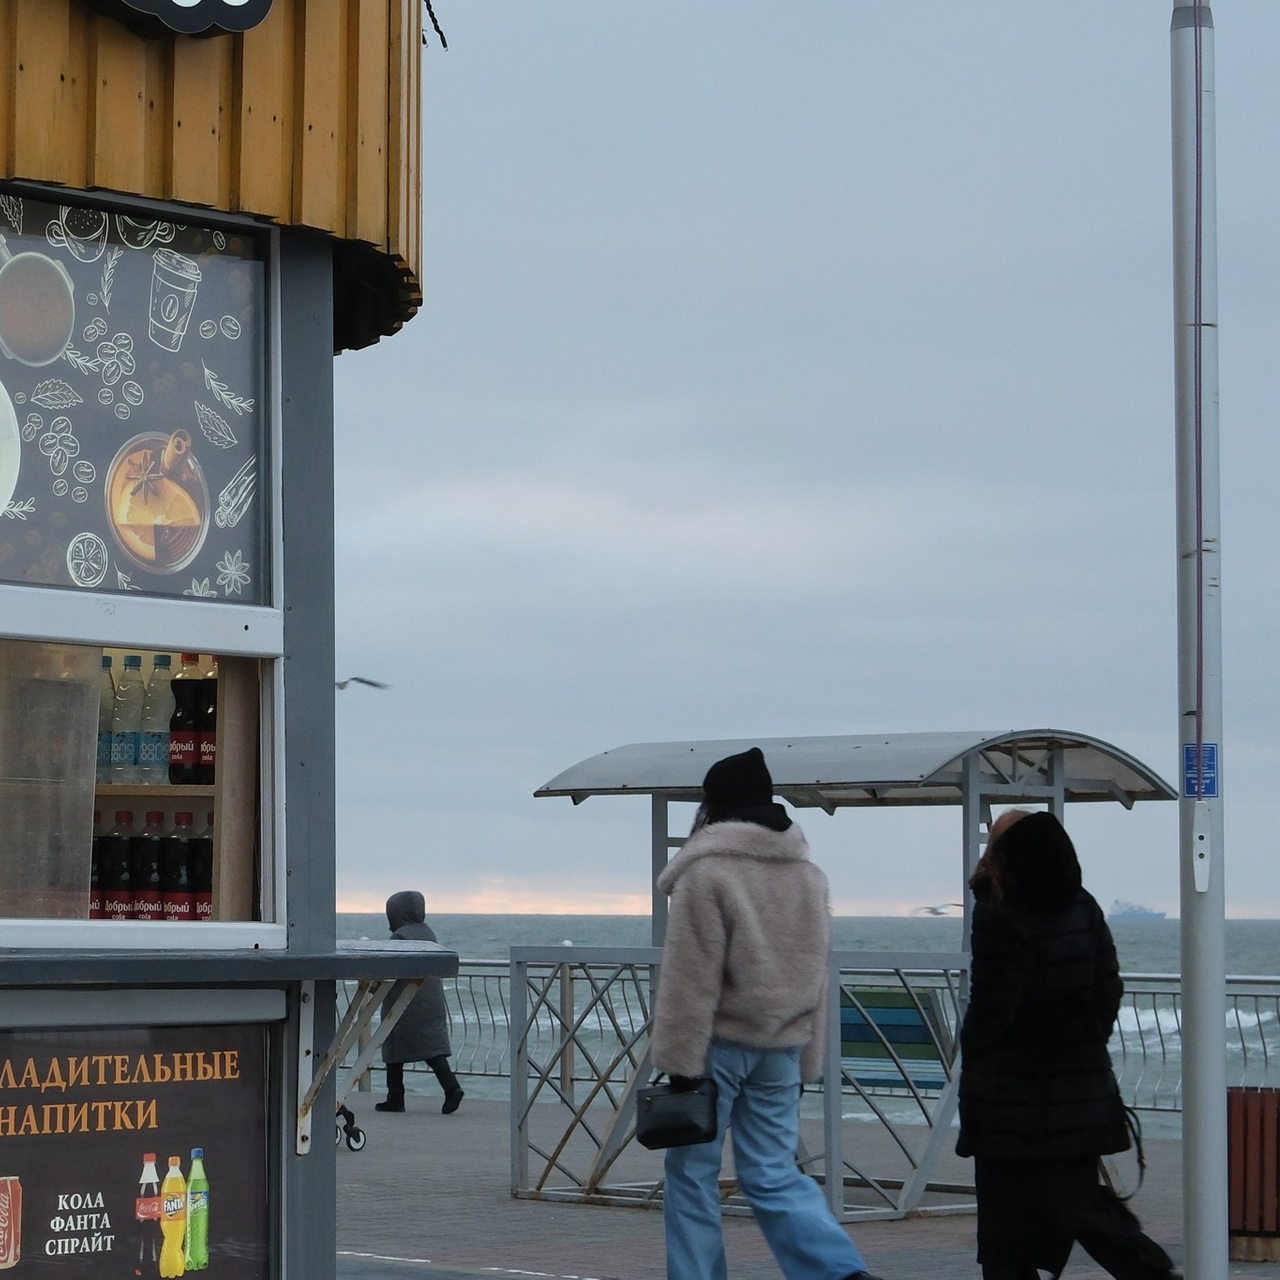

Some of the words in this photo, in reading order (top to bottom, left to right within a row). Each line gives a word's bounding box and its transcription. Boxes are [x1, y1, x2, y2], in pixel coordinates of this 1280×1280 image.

[58, 1191, 105, 1211] КОЛА
[50, 1213, 111, 1232] ФАНТА
[45, 1233, 115, 1256] СПРАЙТ
